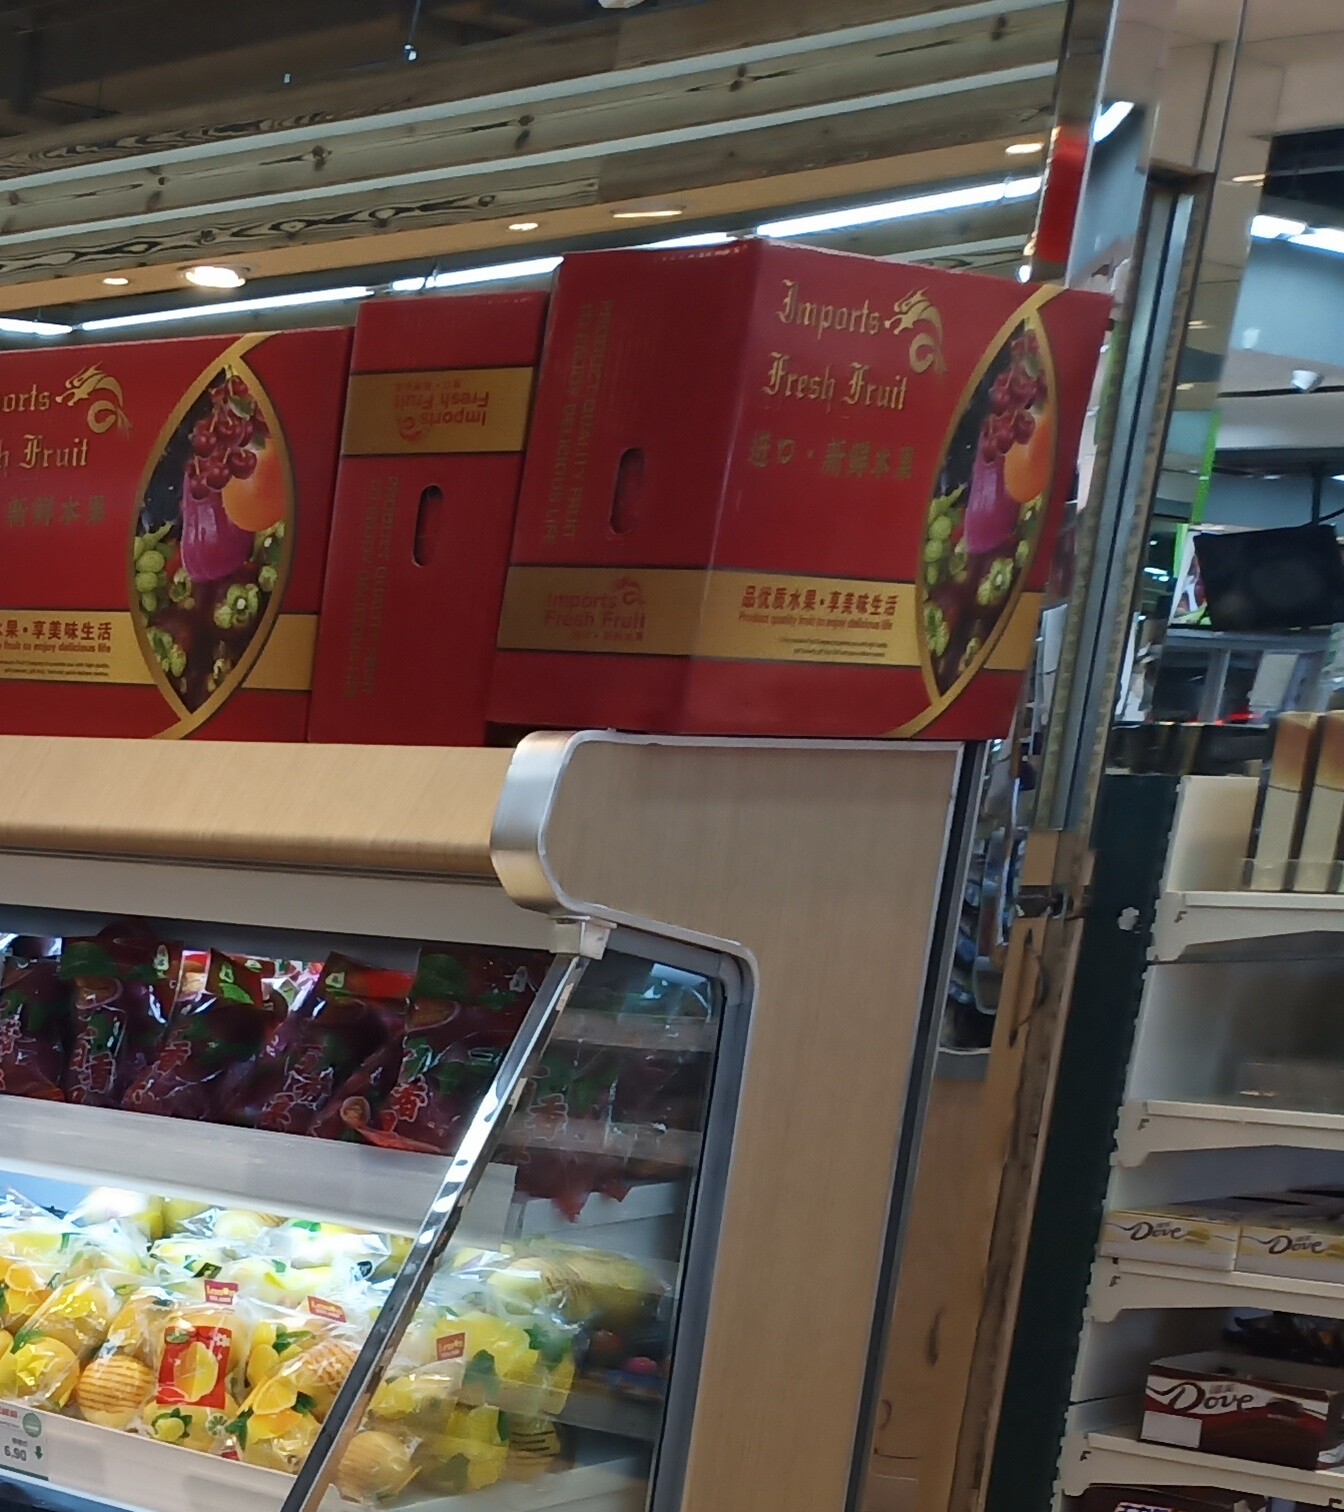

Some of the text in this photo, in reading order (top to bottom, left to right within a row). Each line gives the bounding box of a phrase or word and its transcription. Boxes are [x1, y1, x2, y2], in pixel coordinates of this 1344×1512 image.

[775, 279, 881, 341] Imports
[763, 351, 908, 414] Fresh Fruit
[18, 433, 88, 470] Fruit
[1129, 1220, 1186, 1241] Dove
[1267, 1235, 1326, 1255] Dove
[1165, 1381, 1255, 1414] Dove
